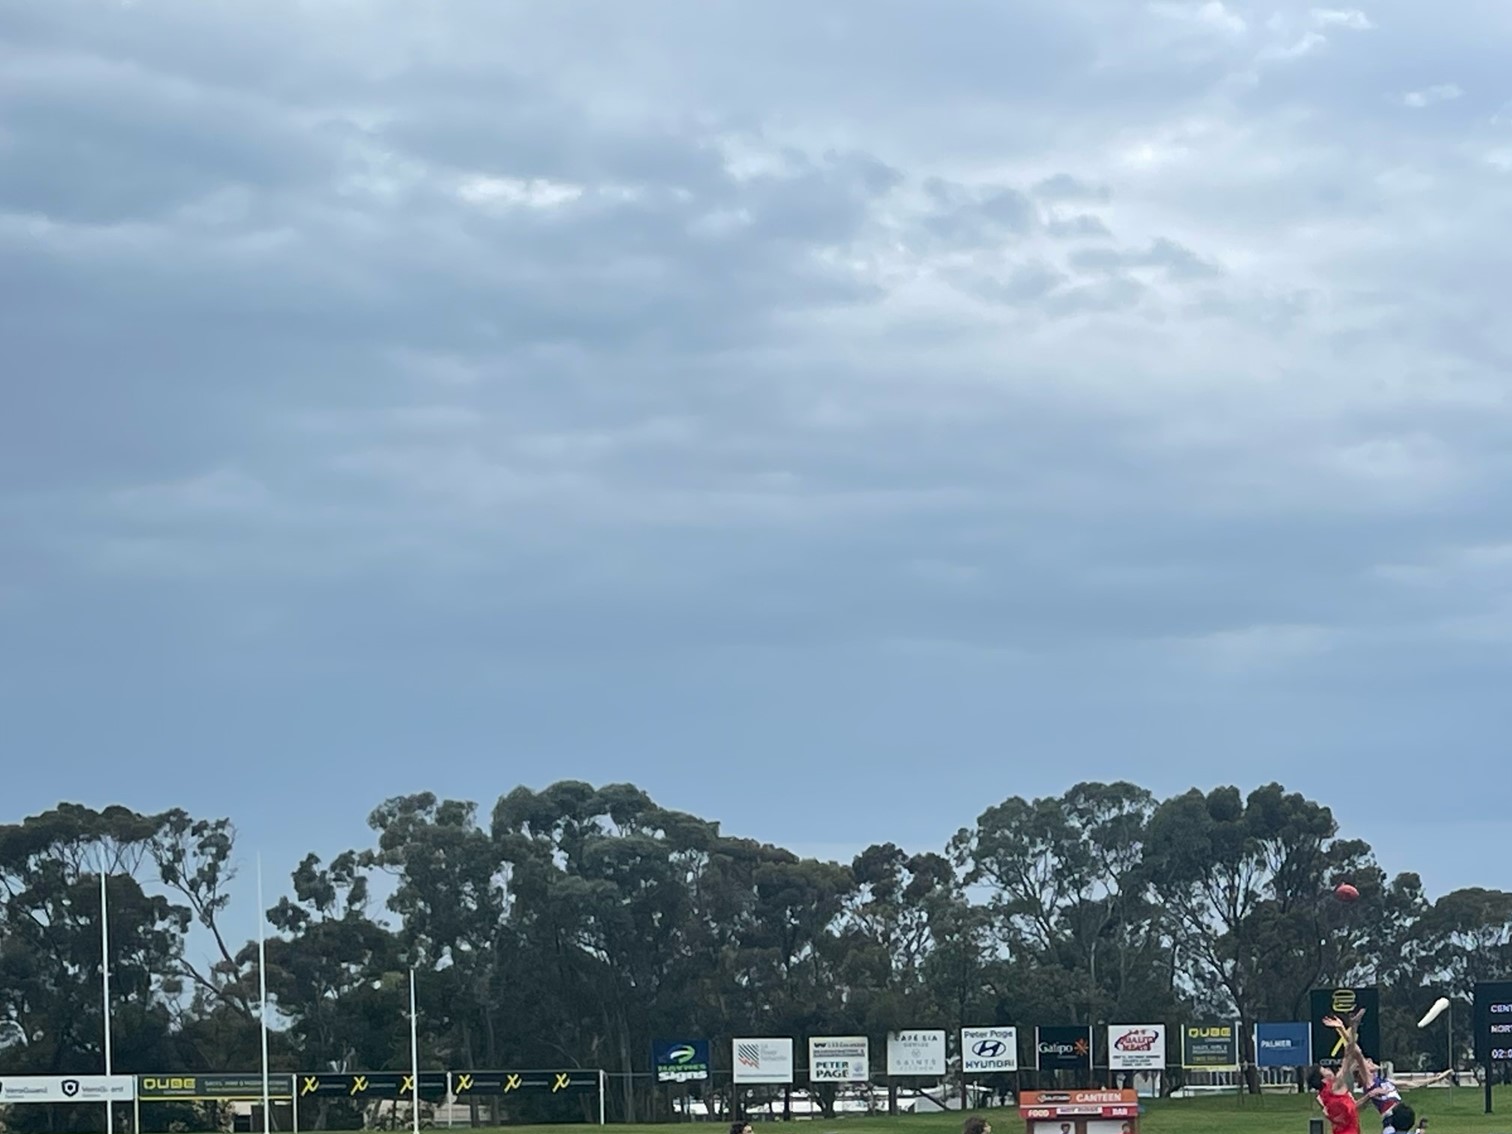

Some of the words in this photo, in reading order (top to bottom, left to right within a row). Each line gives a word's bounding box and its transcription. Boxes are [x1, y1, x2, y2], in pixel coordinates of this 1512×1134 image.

[964, 1031, 988, 1039] Peter
[990, 1030, 1013, 1039] Page
[816, 1061, 849, 1069] PETER
[965, 1060, 1014, 1069] HYUNDAI
[816, 1070, 849, 1078] PAGE
[1076, 1094, 1121, 1103] CANTEEN
[1028, 1109, 1049, 1118] FOOD
